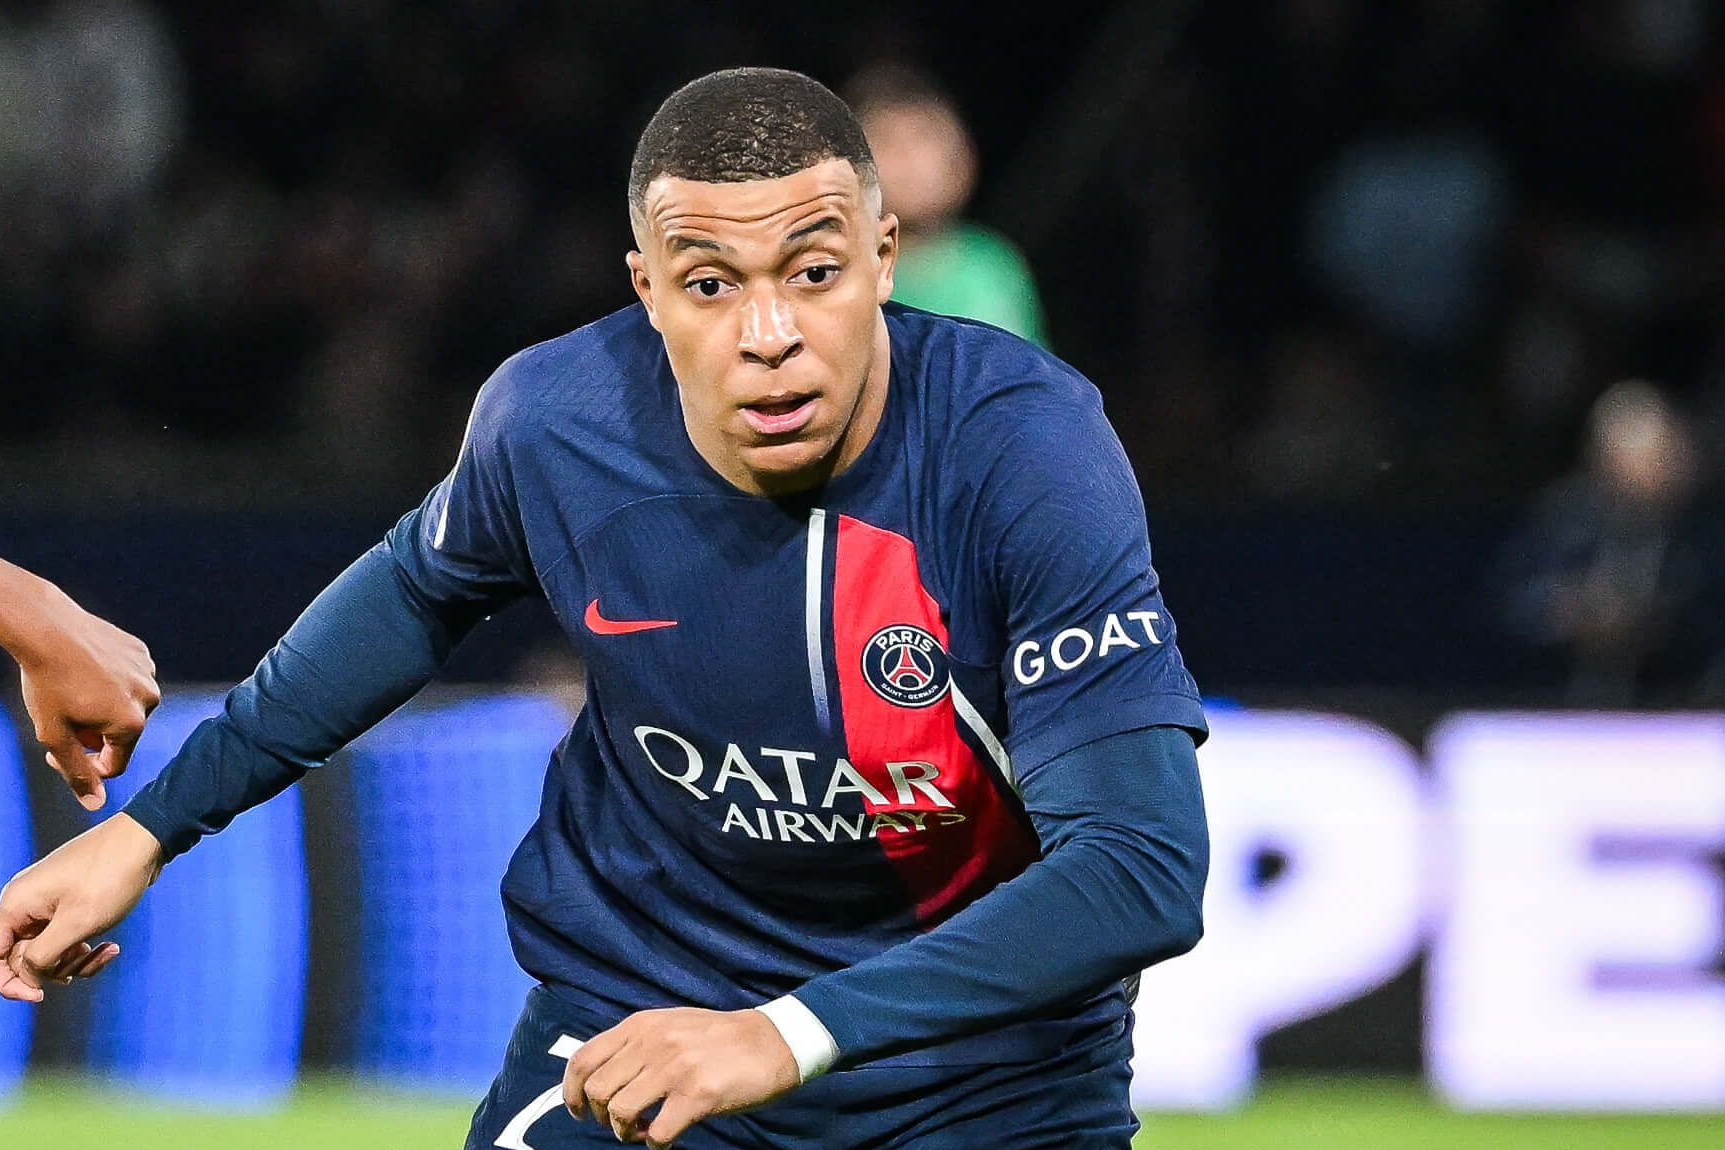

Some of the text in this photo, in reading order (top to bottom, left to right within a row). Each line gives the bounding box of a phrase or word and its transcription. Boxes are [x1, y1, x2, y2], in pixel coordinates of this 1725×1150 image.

[876, 630, 934, 652] PARIS
[1013, 611, 1163, 685] GOAT
[633, 725, 956, 808] QATAR
[721, 803, 967, 843] AIRWAYS
